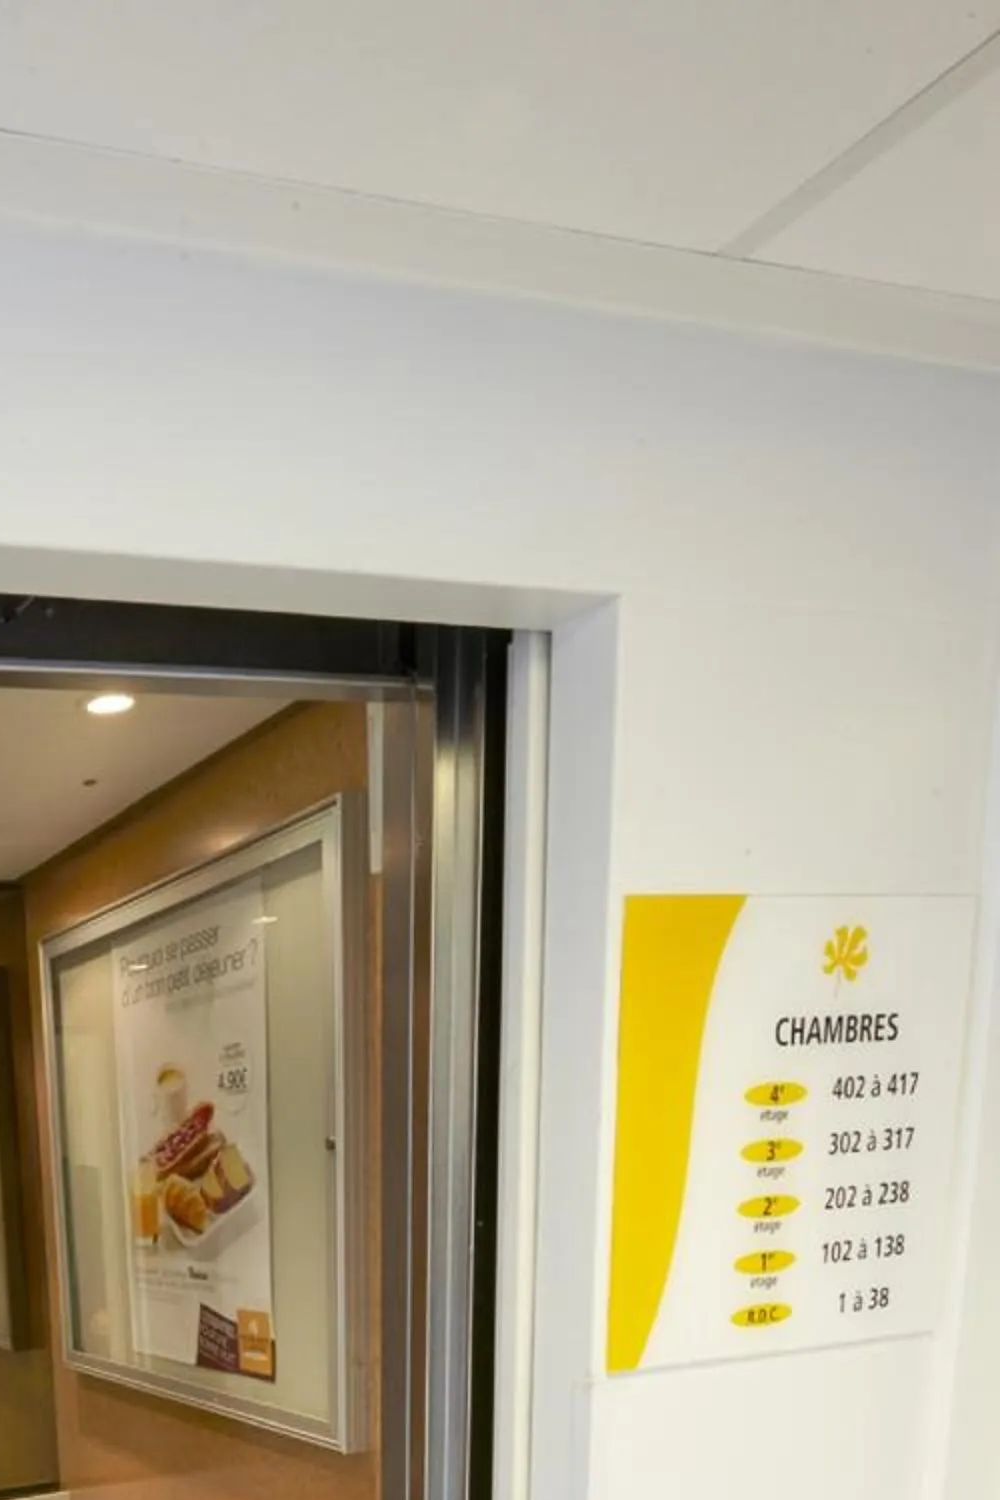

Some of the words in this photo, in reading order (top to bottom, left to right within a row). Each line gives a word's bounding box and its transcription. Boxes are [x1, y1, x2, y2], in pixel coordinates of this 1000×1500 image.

[774, 1012, 900, 1046] CHAMBRES
[832, 1075, 866, 1099] 402
[870, 1074, 882, 1097] à
[887, 1071, 920, 1096] 417
[828, 1130, 862, 1156] 302
[866, 1128, 878, 1152] à
[882, 1126, 915, 1151] 317
[824, 1185, 858, 1210] 202
[861, 1184, 873, 1207] à
[877, 1180, 910, 1206] 238
[821, 1239, 853, 1264] 102
[857, 1237, 868, 1261] à
[874, 1233, 905, 1259] 138
[838, 1291, 847, 1314] 1
[853, 1290, 864, 1313] à
[868, 1287, 890, 1310] 38
